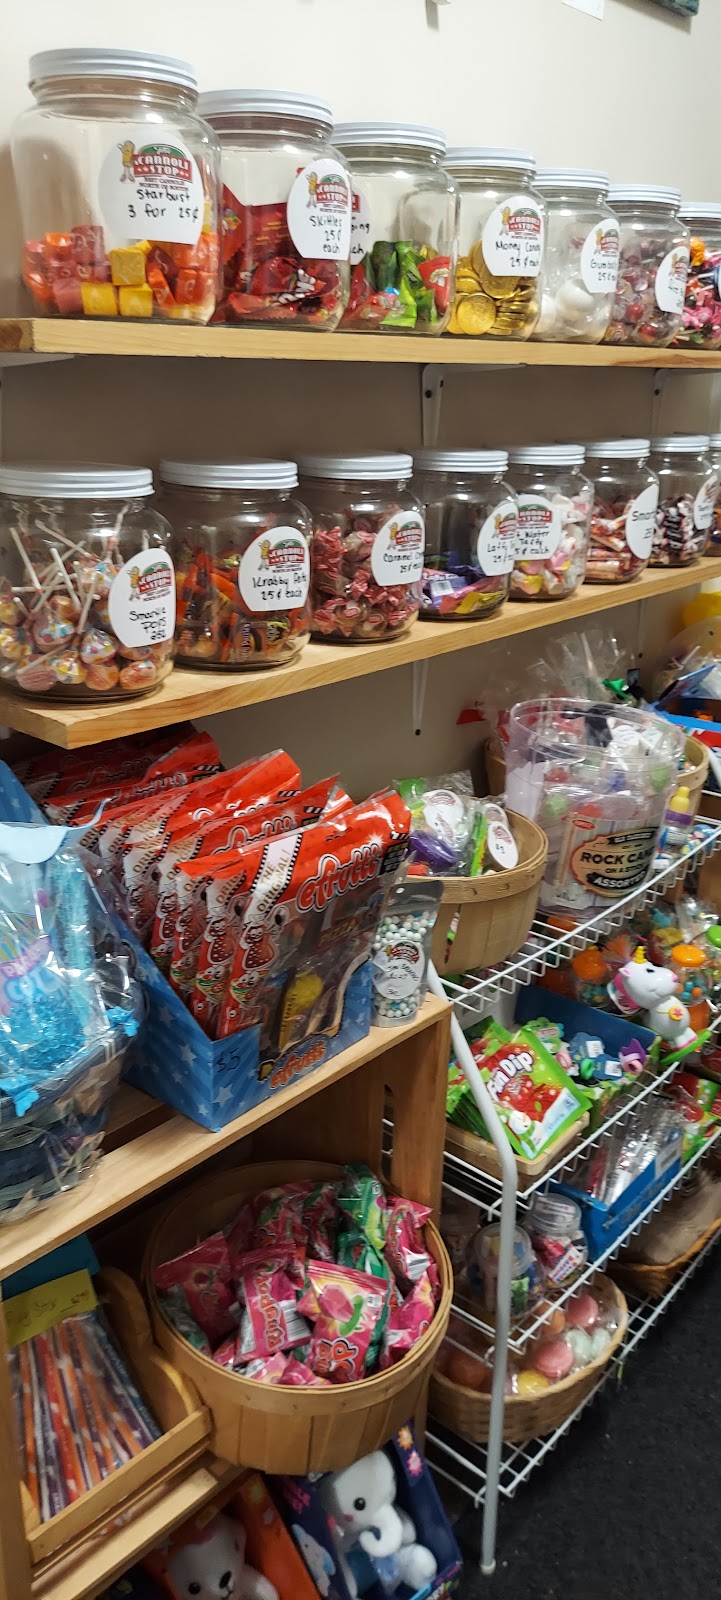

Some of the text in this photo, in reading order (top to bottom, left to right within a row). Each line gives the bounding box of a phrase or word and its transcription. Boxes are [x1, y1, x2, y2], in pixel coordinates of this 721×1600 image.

[150, 165, 179, 176] STOP
[128, 204, 137, 218] 3
[145, 203, 167, 218] for
[580, 851, 625, 866] ROCK
